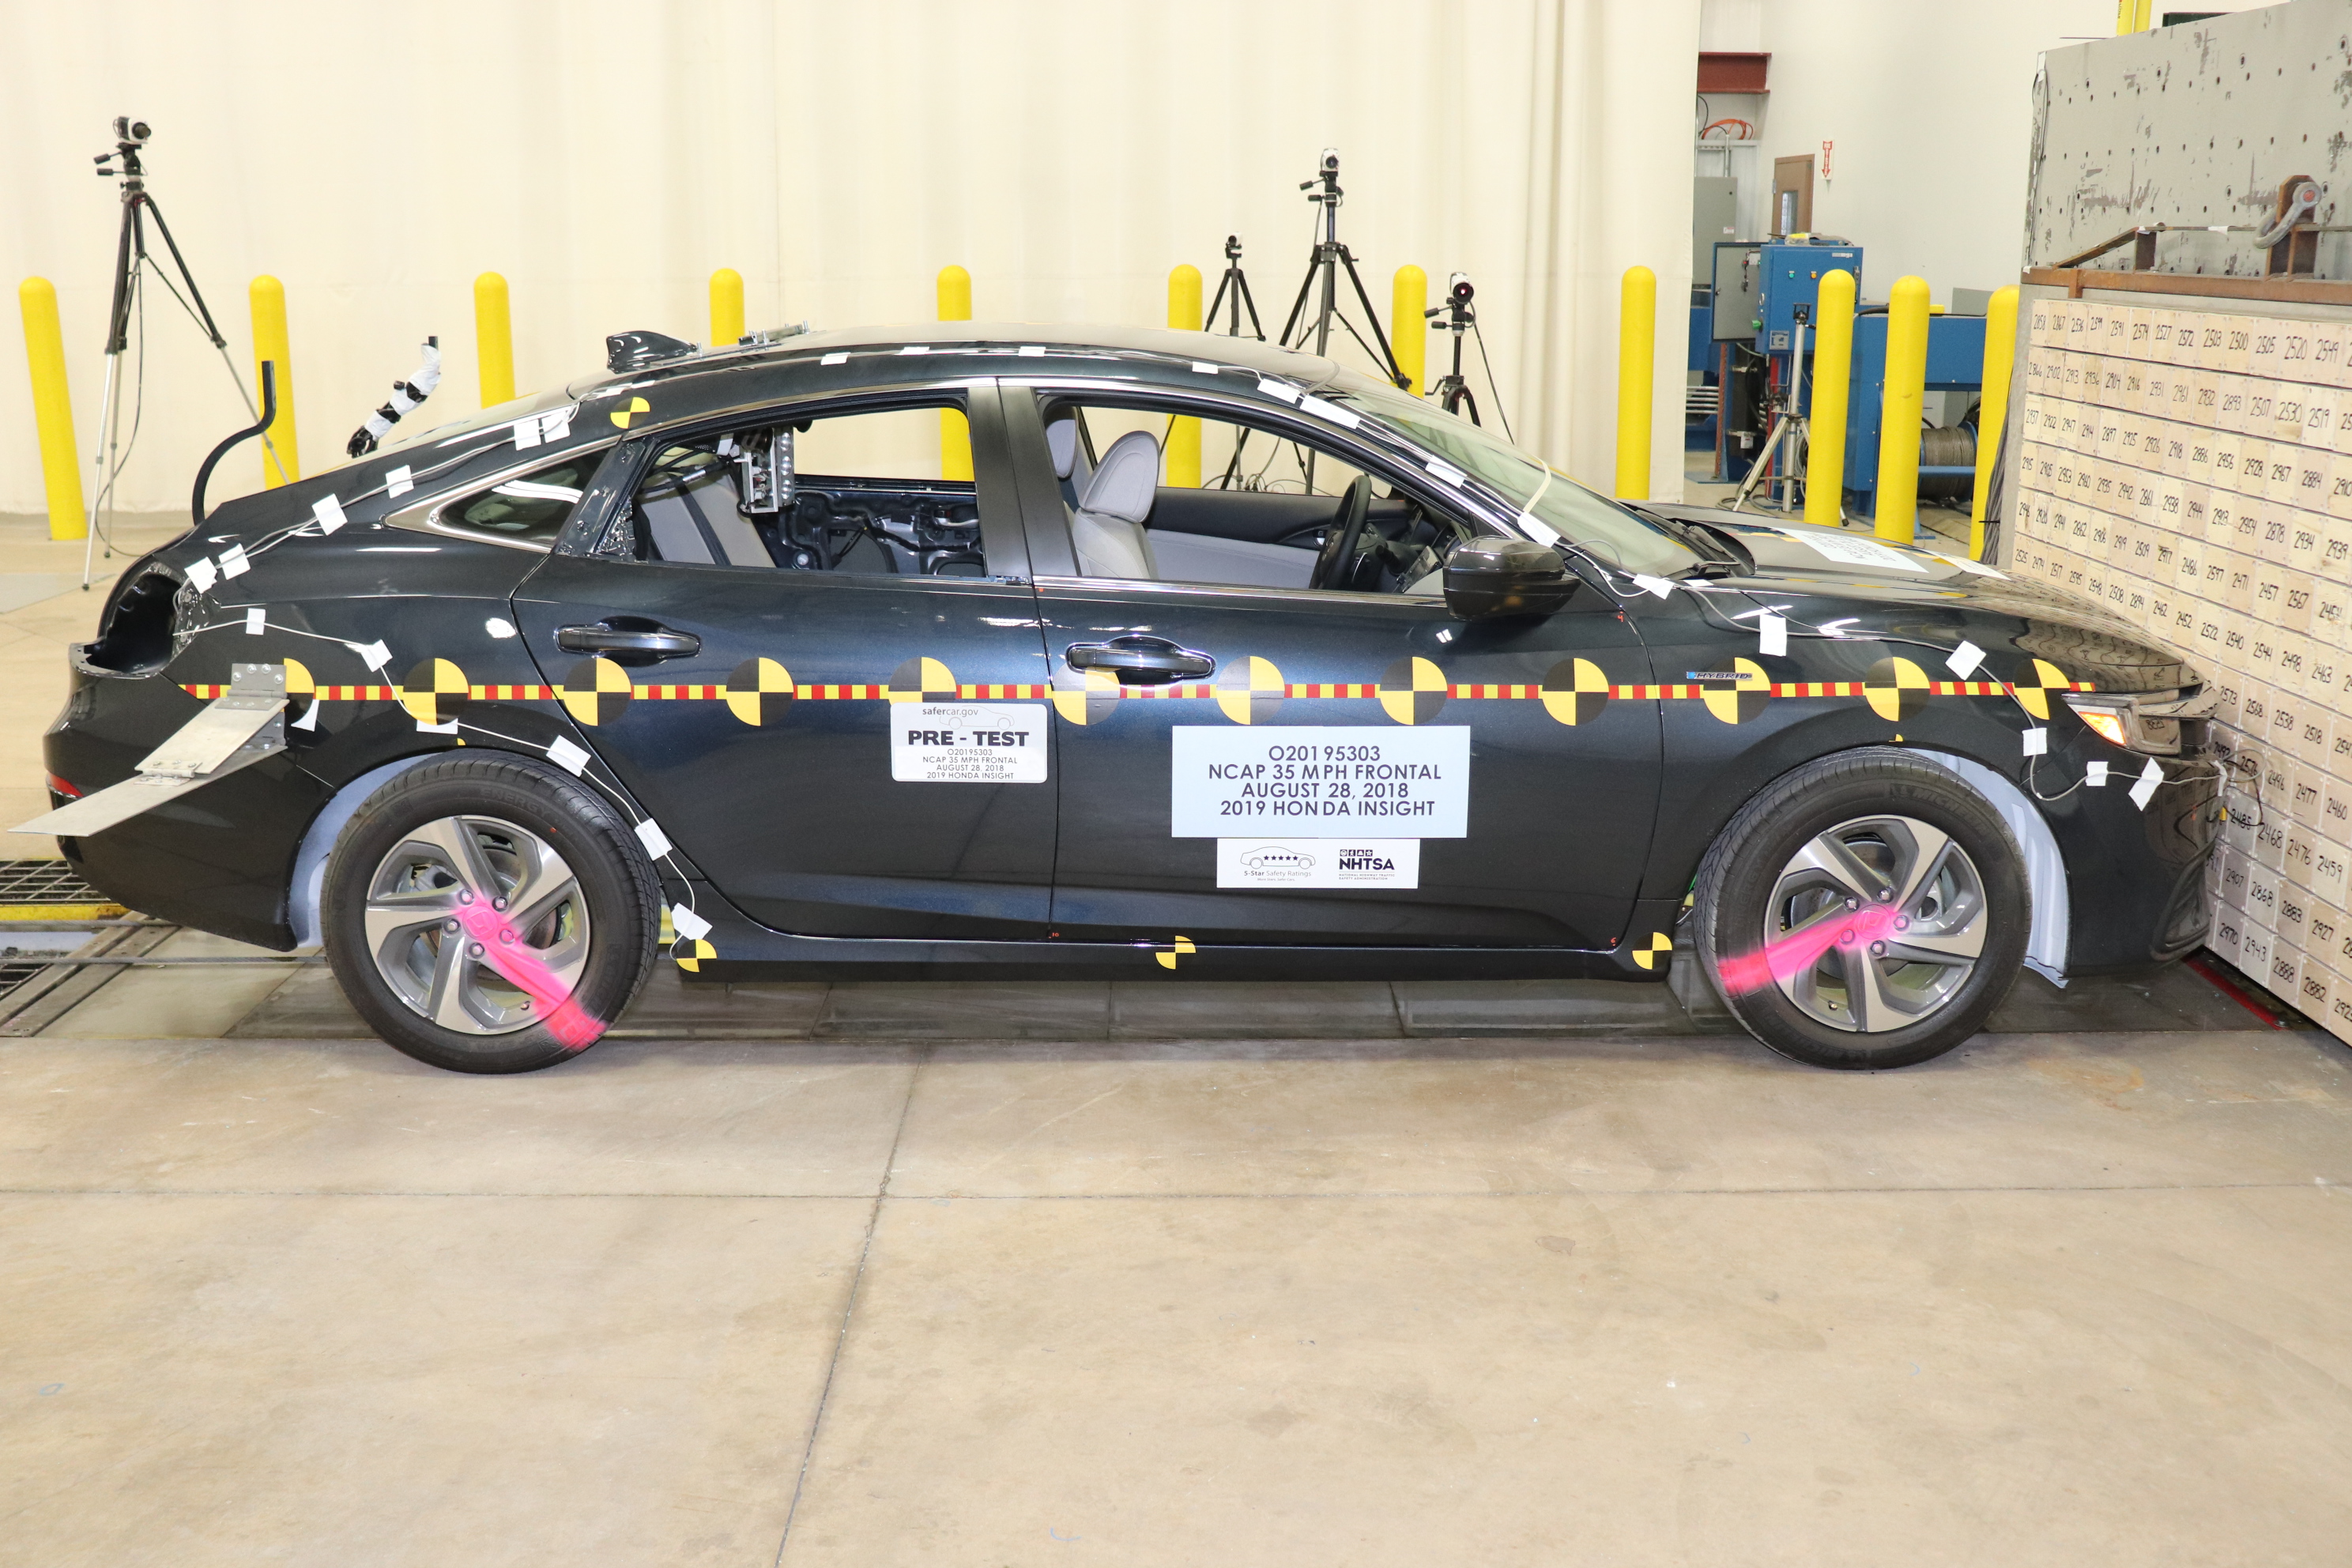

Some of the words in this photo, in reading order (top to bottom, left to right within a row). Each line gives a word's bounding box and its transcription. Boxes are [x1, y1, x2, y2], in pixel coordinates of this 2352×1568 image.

[2053, 315, 2066, 330] 2867
[2071, 318, 2084, 333] 2536
[2111, 320, 2124, 336] 2591
[2132, 323, 2149, 341] 2574
[2155, 325, 2172, 340] 2527
[2177, 330, 2194, 347] 2572
[2203, 329, 2222, 348] 2503
[2229, 331, 2248, 350] 2500
[2256, 336, 2276, 354] 2505
[2284, 336, 2307, 360] 2520
[2316, 339, 2339, 363] 2549
[2029, 362, 2042, 377] 2866
[2047, 366, 2060, 379] 2902
[2066, 369, 2079, 384] 2913
[2085, 371, 2099, 386] 2936
[2105, 372, 2120, 390] 2904
[2128, 376, 2139, 391] 2916
[2150, 382, 2163, 397] 2931
[2173, 385, 2188, 403] 2961
[2198, 388, 2215, 406] 2932
[2223, 394, 2241, 411] 2893
[2250, 397, 2271, 417] 2507
[2278, 402, 2302, 423] 2530
[2308, 408, 2330, 428] 2519
[2026, 409, 2039, 424] 2937
[2044, 414, 2056, 429] 2922
[2062, 418, 2075, 433] 2947
[2082, 424, 2094, 439] 2914
[2101, 427, 2116, 442] 2897
[2123, 432, 2137, 446] 2925
[2145, 436, 2160, 453] 2926
[2169, 440, 2183, 459] 2918
[2192, 447, 2207, 463] 2886
[2217, 452, 2234, 469] 2956
[2245, 458, 2263, 477] 2928
[2271, 464, 2291, 482] 2967
[2301, 469, 2323, 489] 2884
[2022, 457, 2034, 470] 2915
[2058, 467, 2071, 484] 2953
[2078, 472, 2090, 488] 2960
[2097, 477, 2112, 493] 2935
[2118, 482, 2134, 500] 2942
[2139, 488, 2153, 507] 2861
[2162, 495, 2179, 514] 2938
[2188, 501, 2203, 520] 2944
[2238, 516, 2257, 537] 2954
[2265, 521, 2285, 543] 2878
[2294, 531, 2315, 551] 2934
[2326, 539, 2348, 560] 2939
[2073, 520, 2086, 537] 2862
[2094, 529, 2106, 543] 2906
[2114, 535, 2127, 550] 2919
[2135, 541, 2150, 557] 2509
[2181, 557, 2197, 576] 2486
[2207, 565, 2224, 582] 2597
[2232, 572, 2248, 590] 2471
[2259, 582, 2278, 601] 2457
[2287, 590, 2309, 609] 2567
[2015, 548, 2028, 564] 2525
[2032, 556, 2045, 571] 2474
[2050, 563, 2063, 579] 2517
[2069, 571, 2082, 585] 2595
[2089, 579, 2101, 596] 2548
[2109, 585, 2124, 603] 2508
[2130, 594, 2144, 611] 2894
[2153, 601, 2167, 616] 2462
[2176, 611, 2192, 628] 2452
[2201, 623, 2218, 640] 2522
[2226, 631, 2244, 650] 2540
[2253, 642, 2273, 662] 2544
[2282, 650, 2301, 673] 2498
[2312, 664, 2332, 683] 2463
[922, 707, 978, 718] safercar.gov
[2246, 699, 2263, 718] 2568
[2275, 710, 2294, 730] 2538
[2305, 725, 2322, 744] 2518
[909, 730, 954, 745] PRE
[973, 731, 1029, 746] TEST
[1209, 764, 1265, 780] NCAP
[1272, 764, 1295, 780] 35
[1302, 764, 1348, 780] MPH
[1355, 764, 1442, 780] FRONTAL
[1242, 782, 1320, 798] AUGUST
[1329, 782, 1355, 800] 28,
[1363, 782, 1408, 798] 2018
[2268, 770, 2285, 790] 2496
[2296, 783, 2317, 805] 2477
[2327, 797, 2347, 820] 2460
[1220, 801, 1266, 816] 2019
[1273, 801, 1351, 816] HONDA
[1359, 801, 1435, 816] INSIGHT
[1340, 858, 1395, 870] NHTSA
[2258, 822, 2282, 848] 2468
[2287, 839, 2311, 865] 2476
[2317, 855, 2343, 884] 2459
[2226, 869, 2244, 888] 2907
[2252, 881, 2273, 907] 2868
[2282, 900, 2302, 923] 2883
[2312, 919, 2334, 942] 2927
[2219, 923, 2238, 945] 2970
[2245, 937, 2267, 962] 2943
[2273, 957, 2294, 983] 2888
[2304, 977, 2327, 1003] 2882
